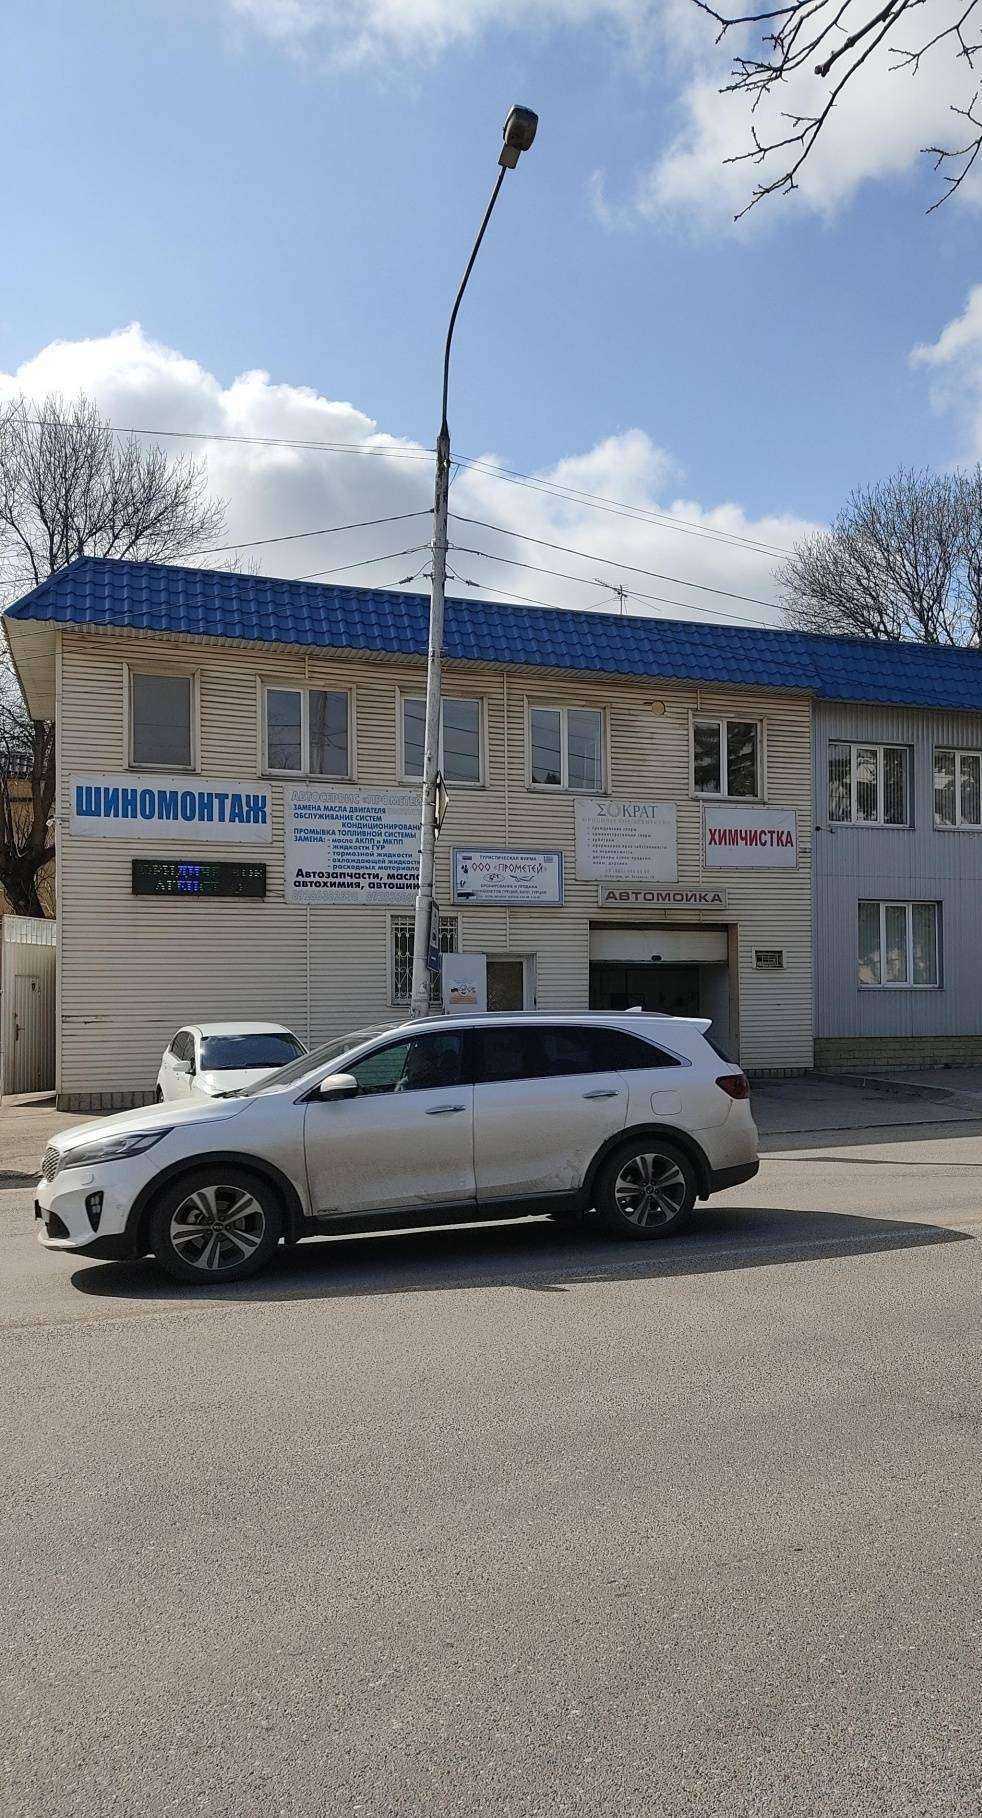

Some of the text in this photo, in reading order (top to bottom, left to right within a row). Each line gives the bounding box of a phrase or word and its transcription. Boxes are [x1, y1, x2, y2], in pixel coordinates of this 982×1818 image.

[75, 785, 267, 825] ШИНОМОНТАЖ
[293, 804, 321, 812] ЗАМЕНА
[349, 807, 386, 815] ДВИГАТЕЛЯ
[293, 812, 354, 821] ОБСЛУЖИВАНИЕ
[293, 828, 336, 836] ПРОМЫВКА
[338, 829, 383, 838] ТОПЛИВНОЙ
[708, 828, 795, 848] ХИМЧИСТКА
[471, 862, 491, 872] ООО
[295, 868, 384, 881] Автозапчасти,
[293, 880, 420, 890] автохимия, автошин
